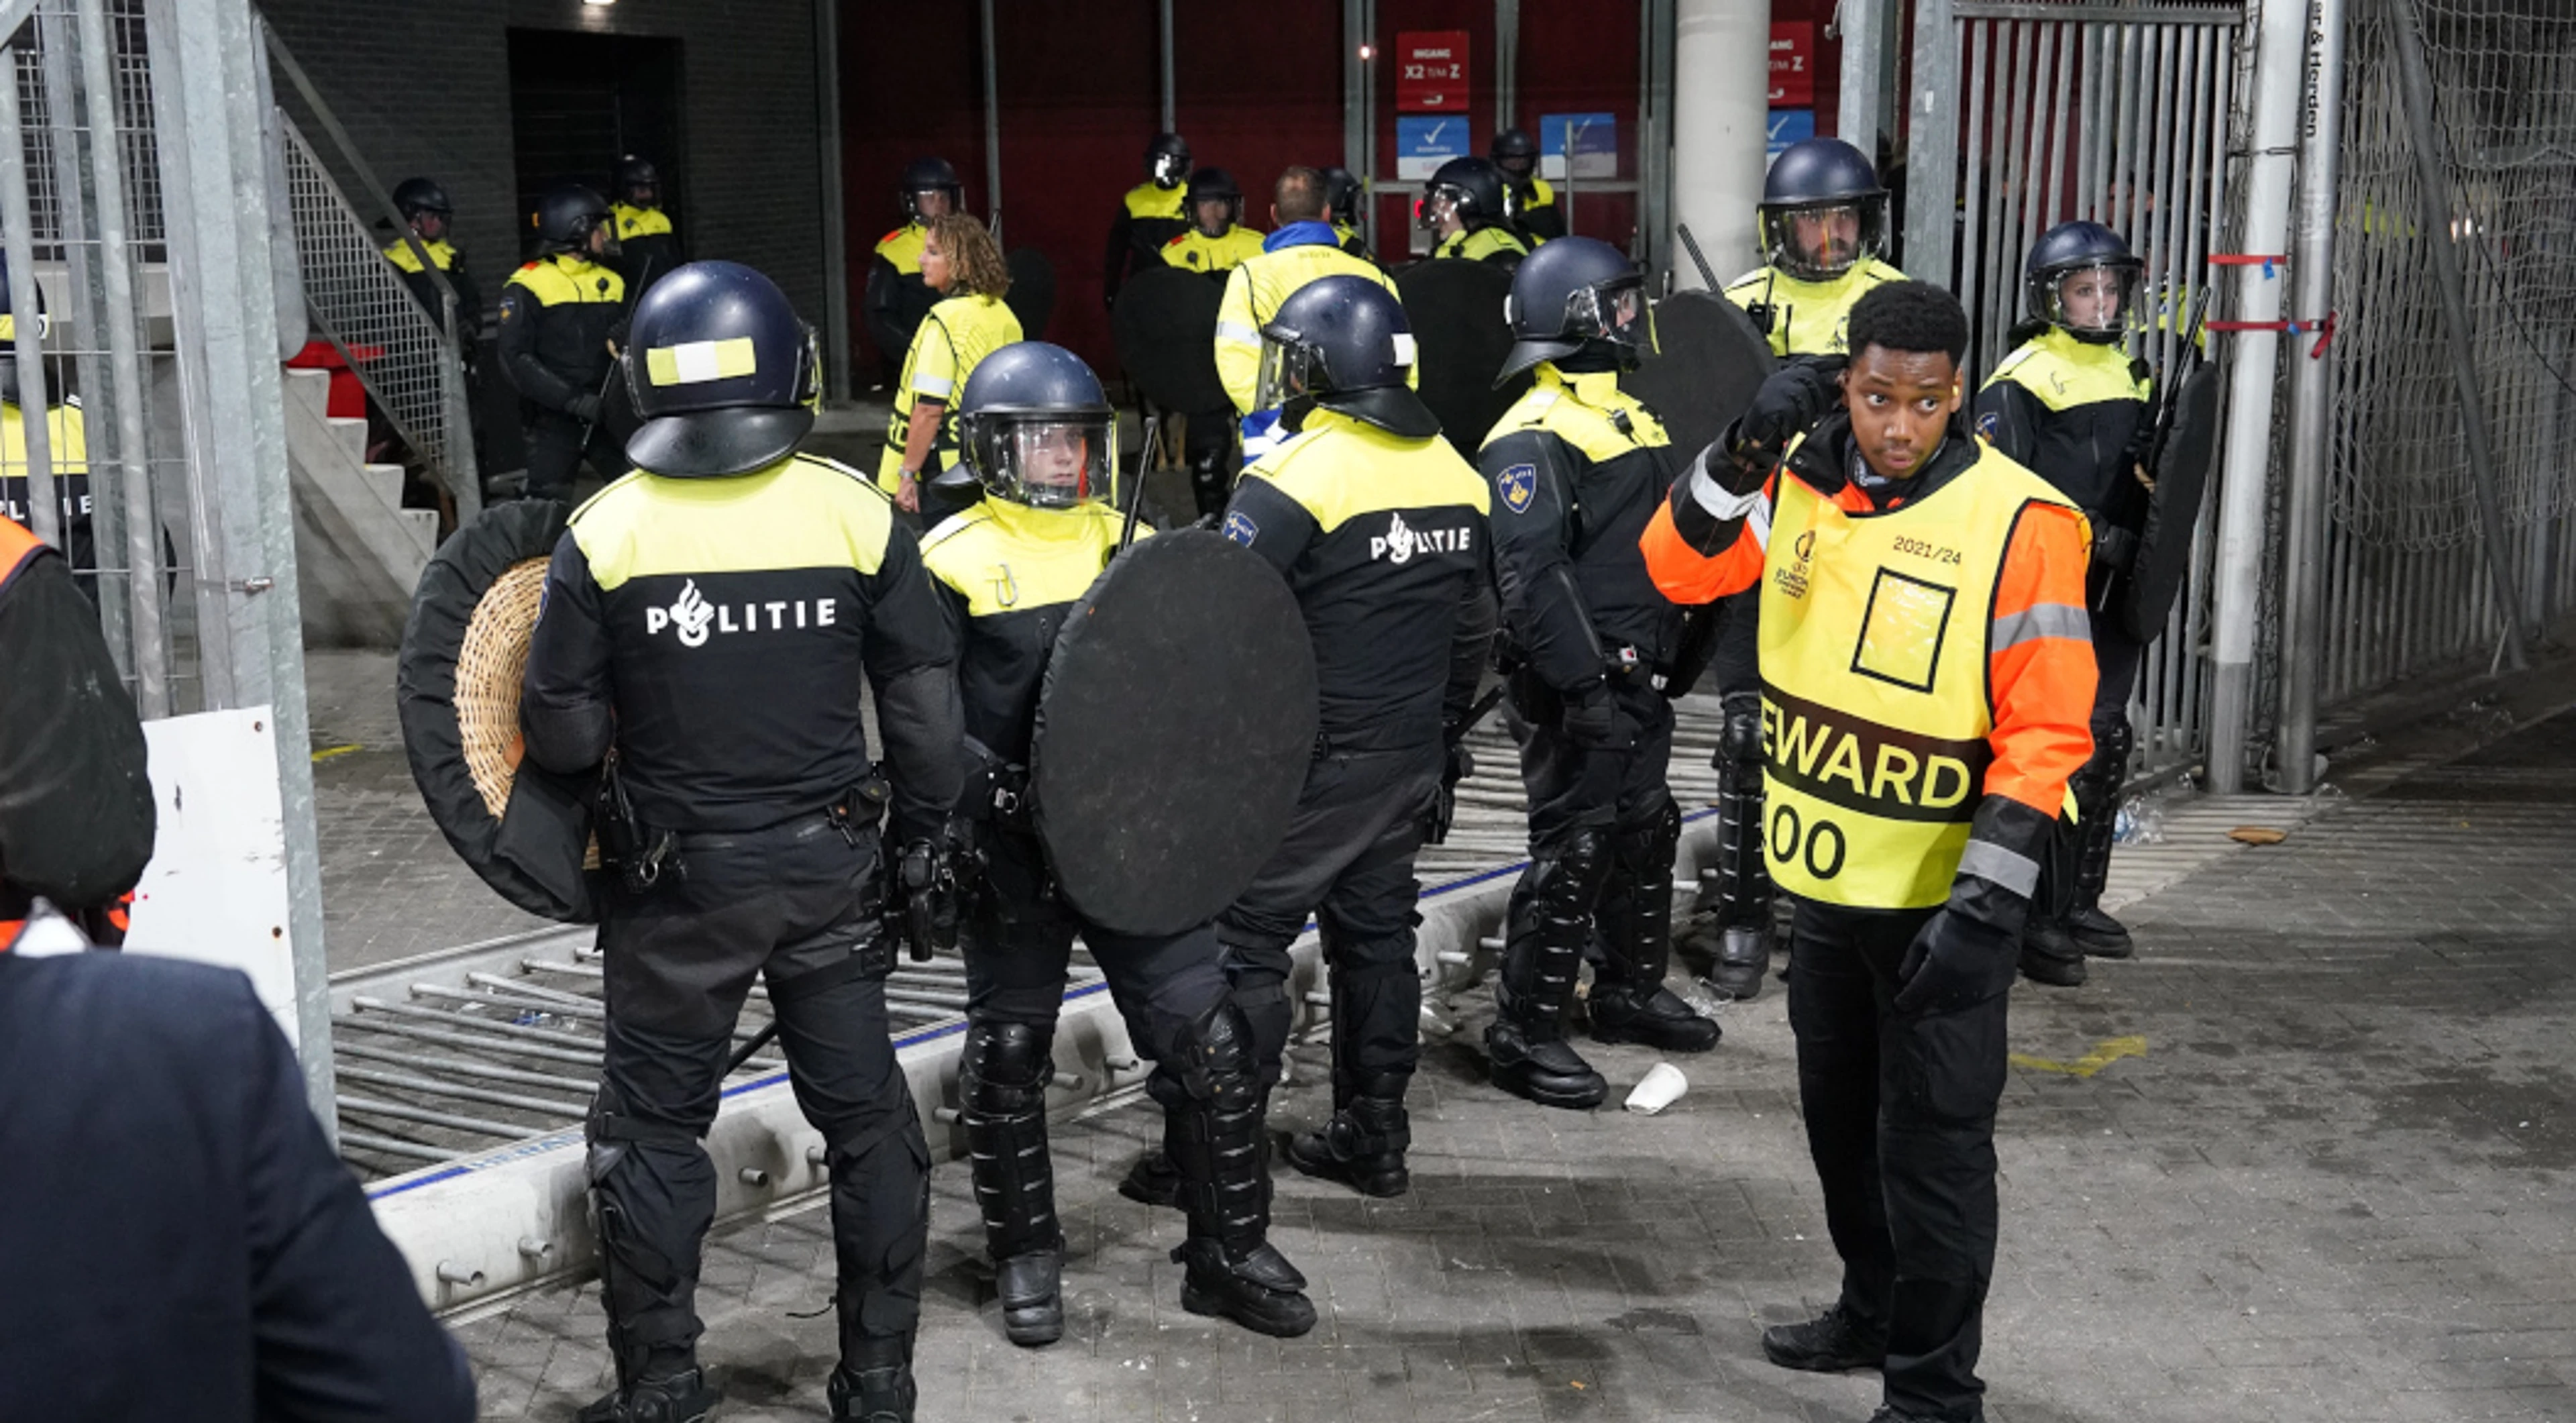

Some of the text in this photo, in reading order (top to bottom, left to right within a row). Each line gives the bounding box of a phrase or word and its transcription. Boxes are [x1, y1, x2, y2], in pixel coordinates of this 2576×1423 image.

[2311, 31, 2324, 46] &
[1405, 64, 1424, 79] X2
[1450, 63, 1460, 79] Z
[1792, 56, 1804, 72] Z
[1893, 535, 1962, 565] 2021/24
[646, 578, 836, 647] POLITIE
